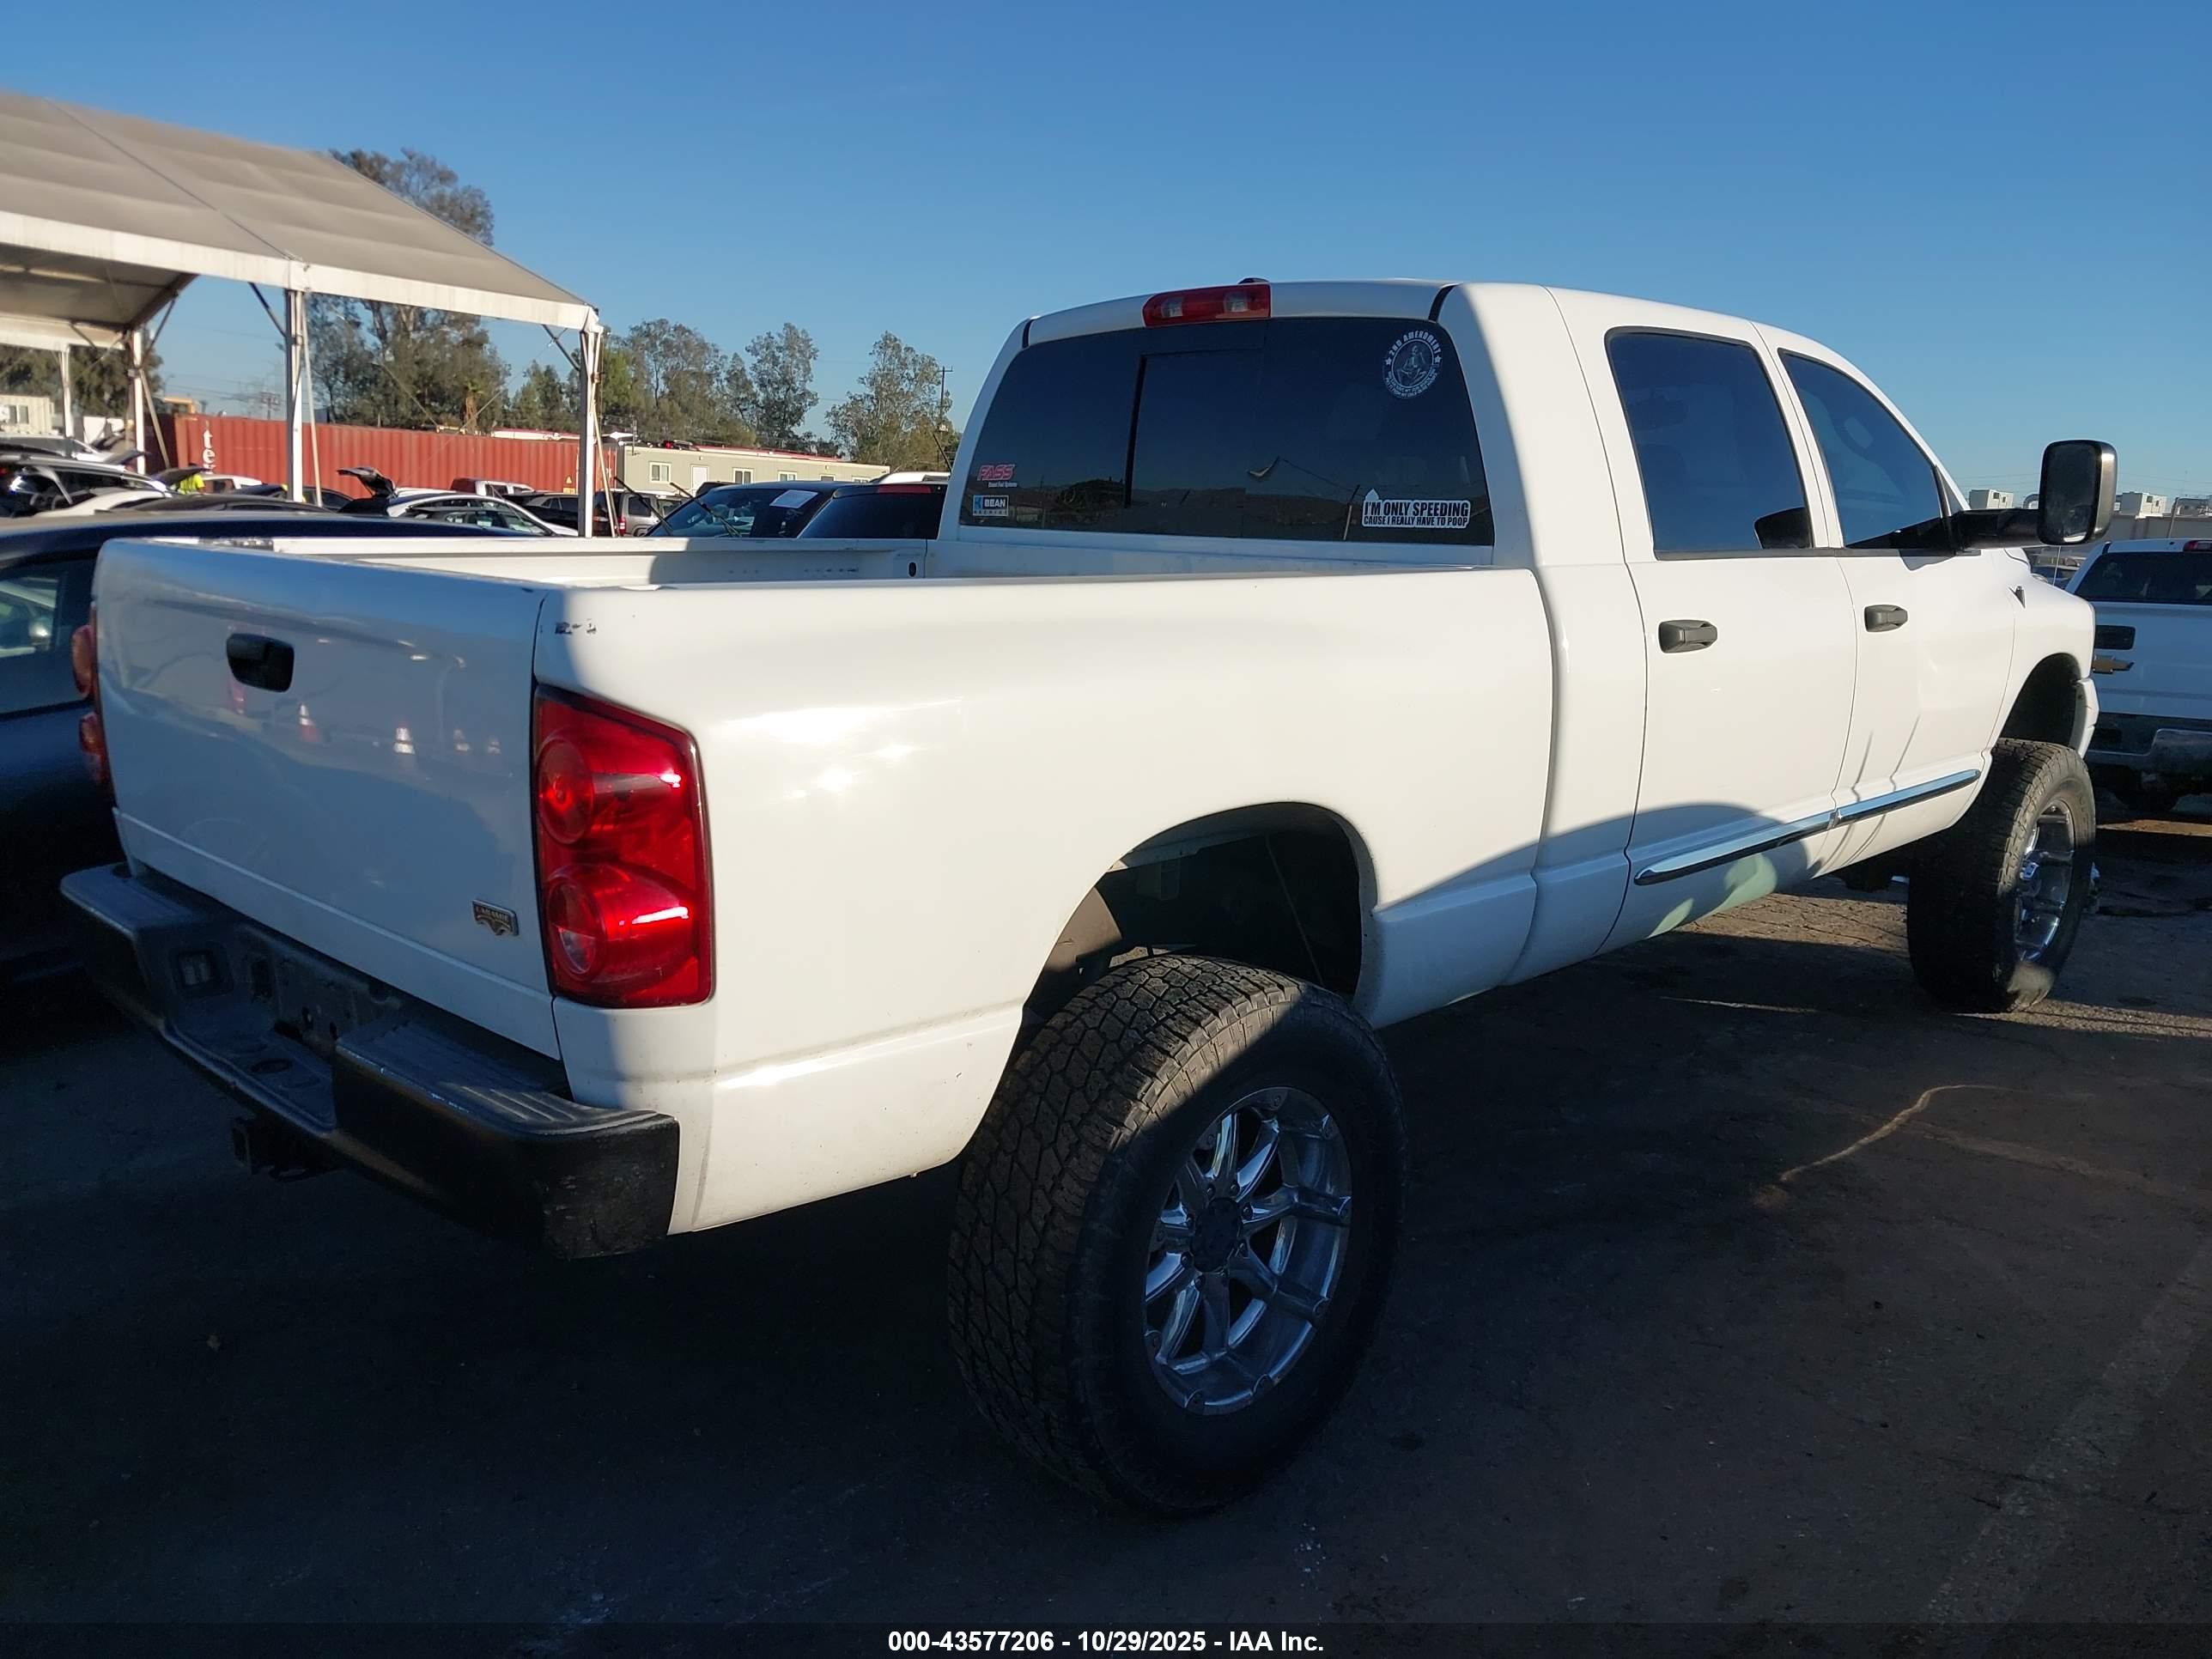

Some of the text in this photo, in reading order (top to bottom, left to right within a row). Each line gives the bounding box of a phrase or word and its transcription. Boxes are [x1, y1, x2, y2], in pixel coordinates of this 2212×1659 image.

[1389, 331, 1442, 356] 2ND AMENDMENT
[977, 464, 1015, 481] FASS
[984, 499, 1006, 507] BEAN
[1364, 501, 1469, 517] I'M ONLY SPEEDING
[1364, 516, 1386, 525] CAUSE
[1390, 516, 1415, 526] REALLY
[1417, 516, 1435, 526] HAVE
[1437, 517, 1446, 526] TO
[1447, 517, 1468, 526] POOP
